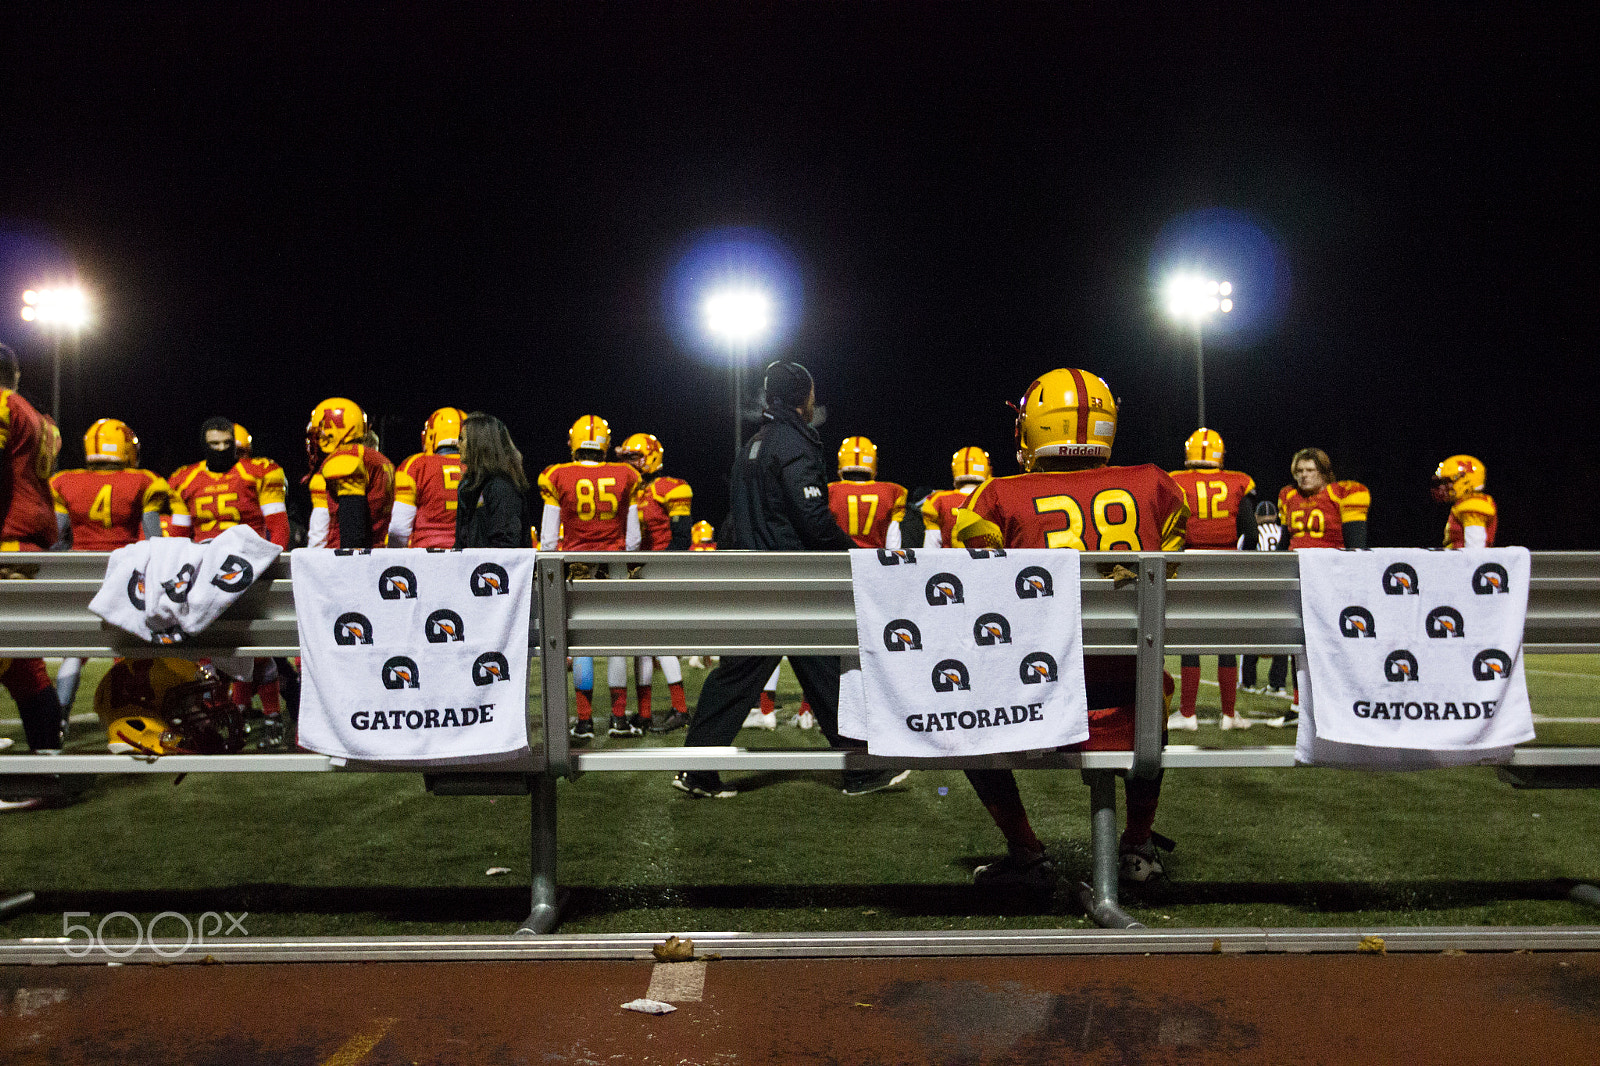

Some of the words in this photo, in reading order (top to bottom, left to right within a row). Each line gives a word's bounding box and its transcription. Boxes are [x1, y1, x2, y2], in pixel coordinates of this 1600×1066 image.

[323, 408, 346, 428] N
[1059, 446, 1101, 456] Riddell
[89, 484, 112, 529] 4
[195, 492, 241, 531] 55
[576, 477, 618, 521] 85
[847, 494, 879, 535] 17
[1196, 480, 1229, 519] 12
[1032, 487, 1144, 551] 38
[1291, 509, 1325, 538] 50
[351, 704, 494, 730] GATORADE
[906, 703, 1043, 732] GATORADE
[1353, 700, 1498, 720] GATORADE
